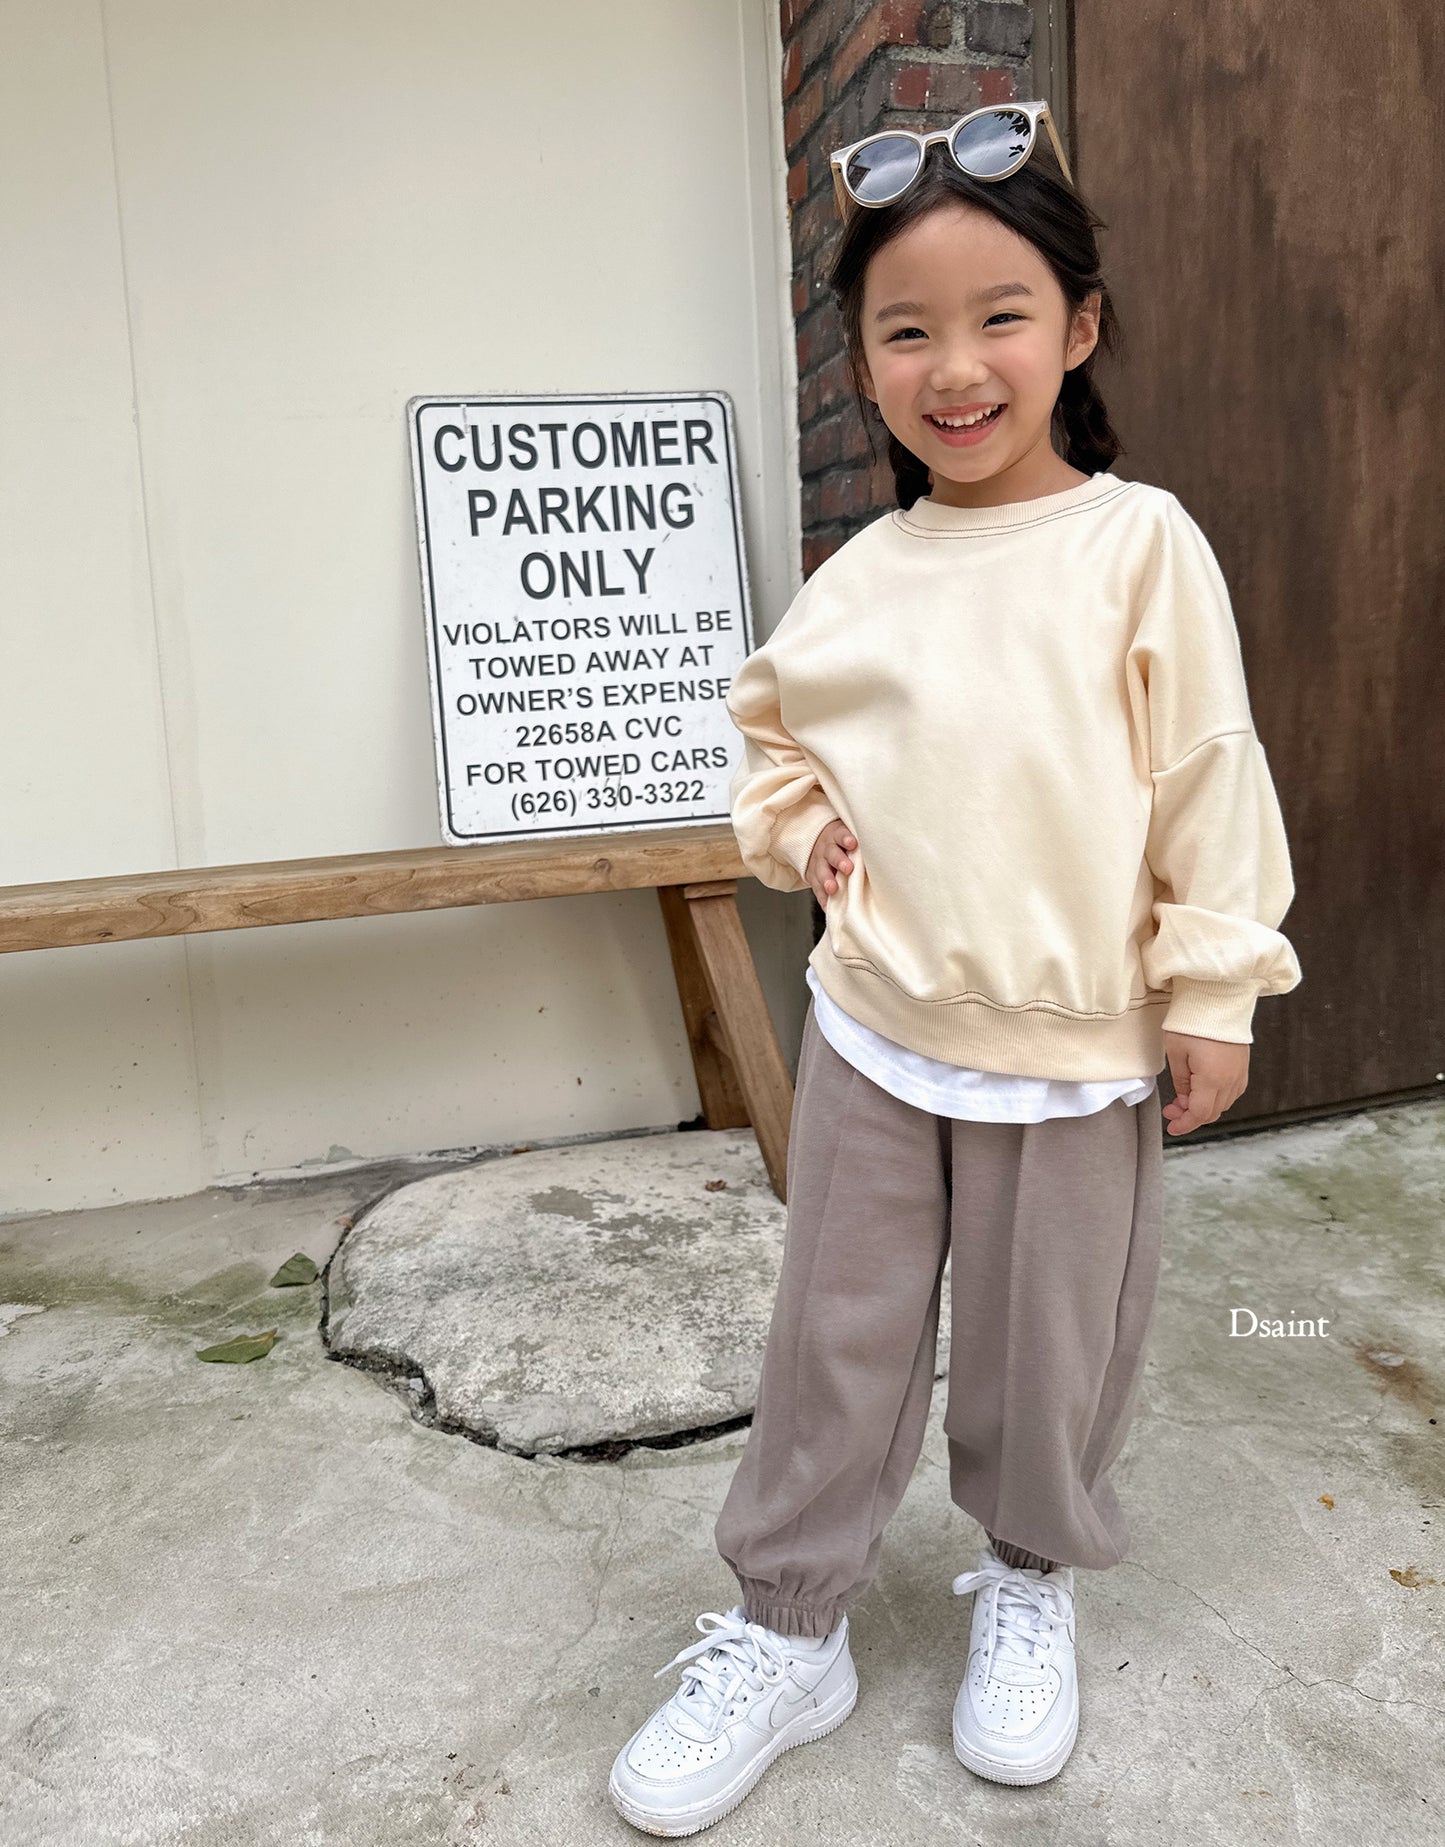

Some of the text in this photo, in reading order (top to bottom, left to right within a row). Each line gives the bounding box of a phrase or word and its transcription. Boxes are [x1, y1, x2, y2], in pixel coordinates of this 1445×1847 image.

[434, 419, 718, 473] CUSTOMER
[468, 482, 695, 537] PARKING
[520, 548, 656, 600] ONLY
[443, 610, 733, 646] VIOLATORS WILL BE
[469, 645, 714, 680] TOWED AWAY AT
[456, 677, 732, 716] OWNER’S EXPENSE
[516, 715, 682, 748] 22658A CVC
[466, 746, 729, 786] FOR TOWED CARS
[511, 780, 706, 821] (626) 330-3322
